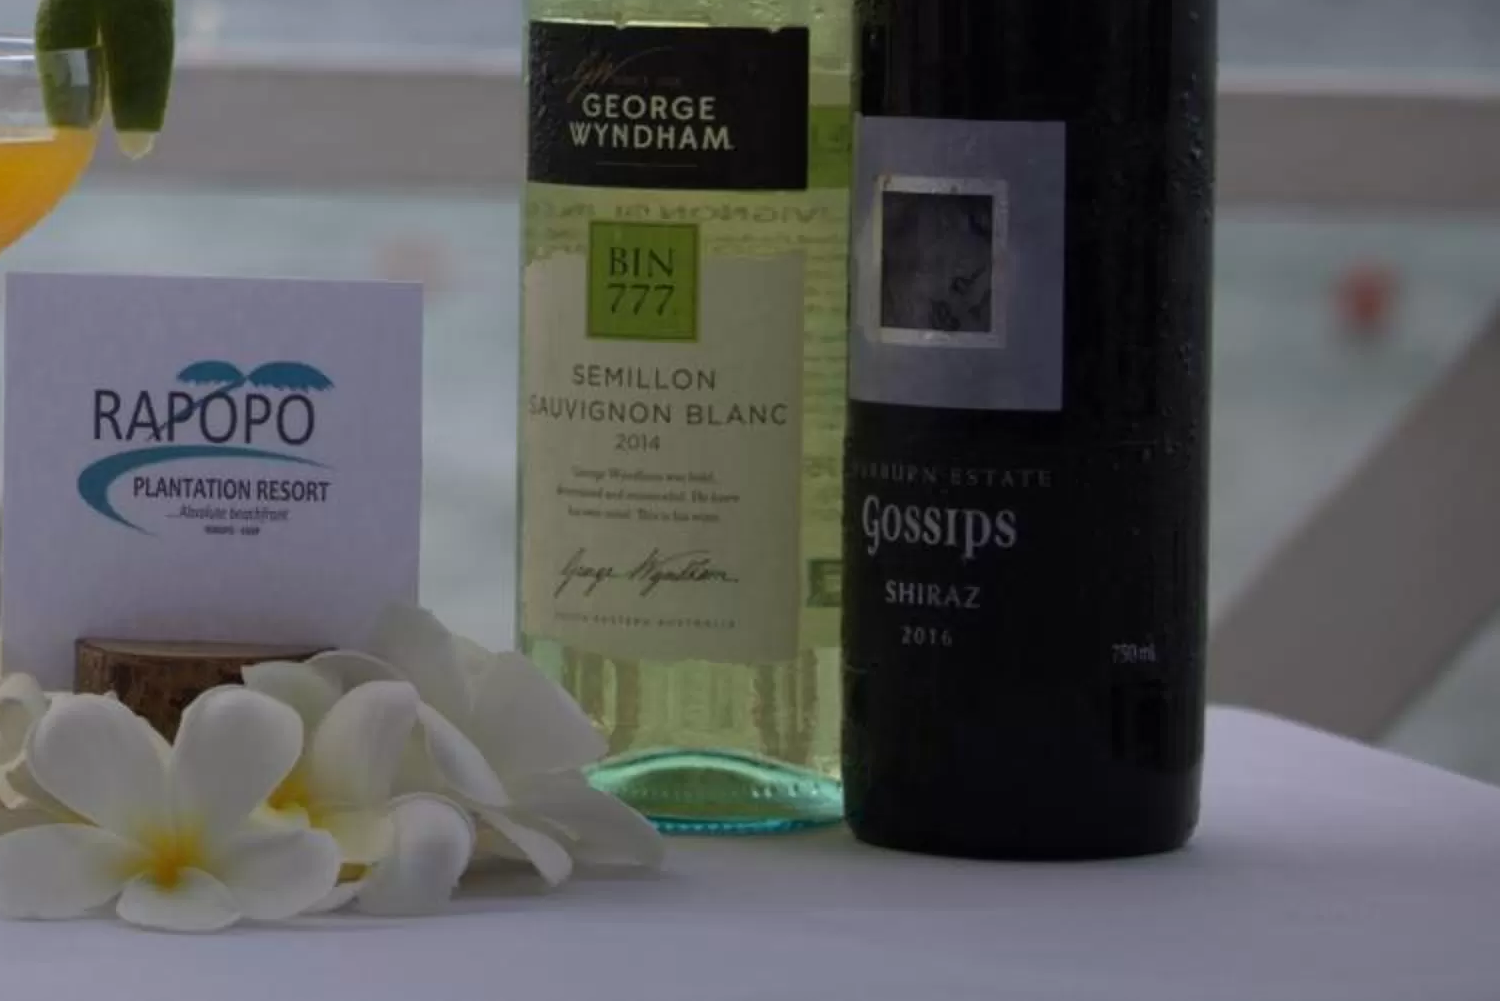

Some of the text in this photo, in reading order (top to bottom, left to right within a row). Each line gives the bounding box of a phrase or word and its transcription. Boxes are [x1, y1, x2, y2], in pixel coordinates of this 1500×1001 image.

[582, 93, 717, 122] GEORGE
[568, 121, 735, 151] WYNDHAM
[608, 246, 677, 278] BIN
[607, 282, 675, 316] 777
[571, 363, 717, 392] SEMILLON
[92, 389, 316, 446] RAPOPO
[528, 394, 789, 426] SAUVIGNON BLANC
[614, 433, 661, 452] 2014
[132, 476, 332, 503] PLANTATION RESORT
[949, 467, 1053, 488] ESTATE
[884, 579, 981, 609] SHIRAZ
[901, 626, 952, 647] 2016
